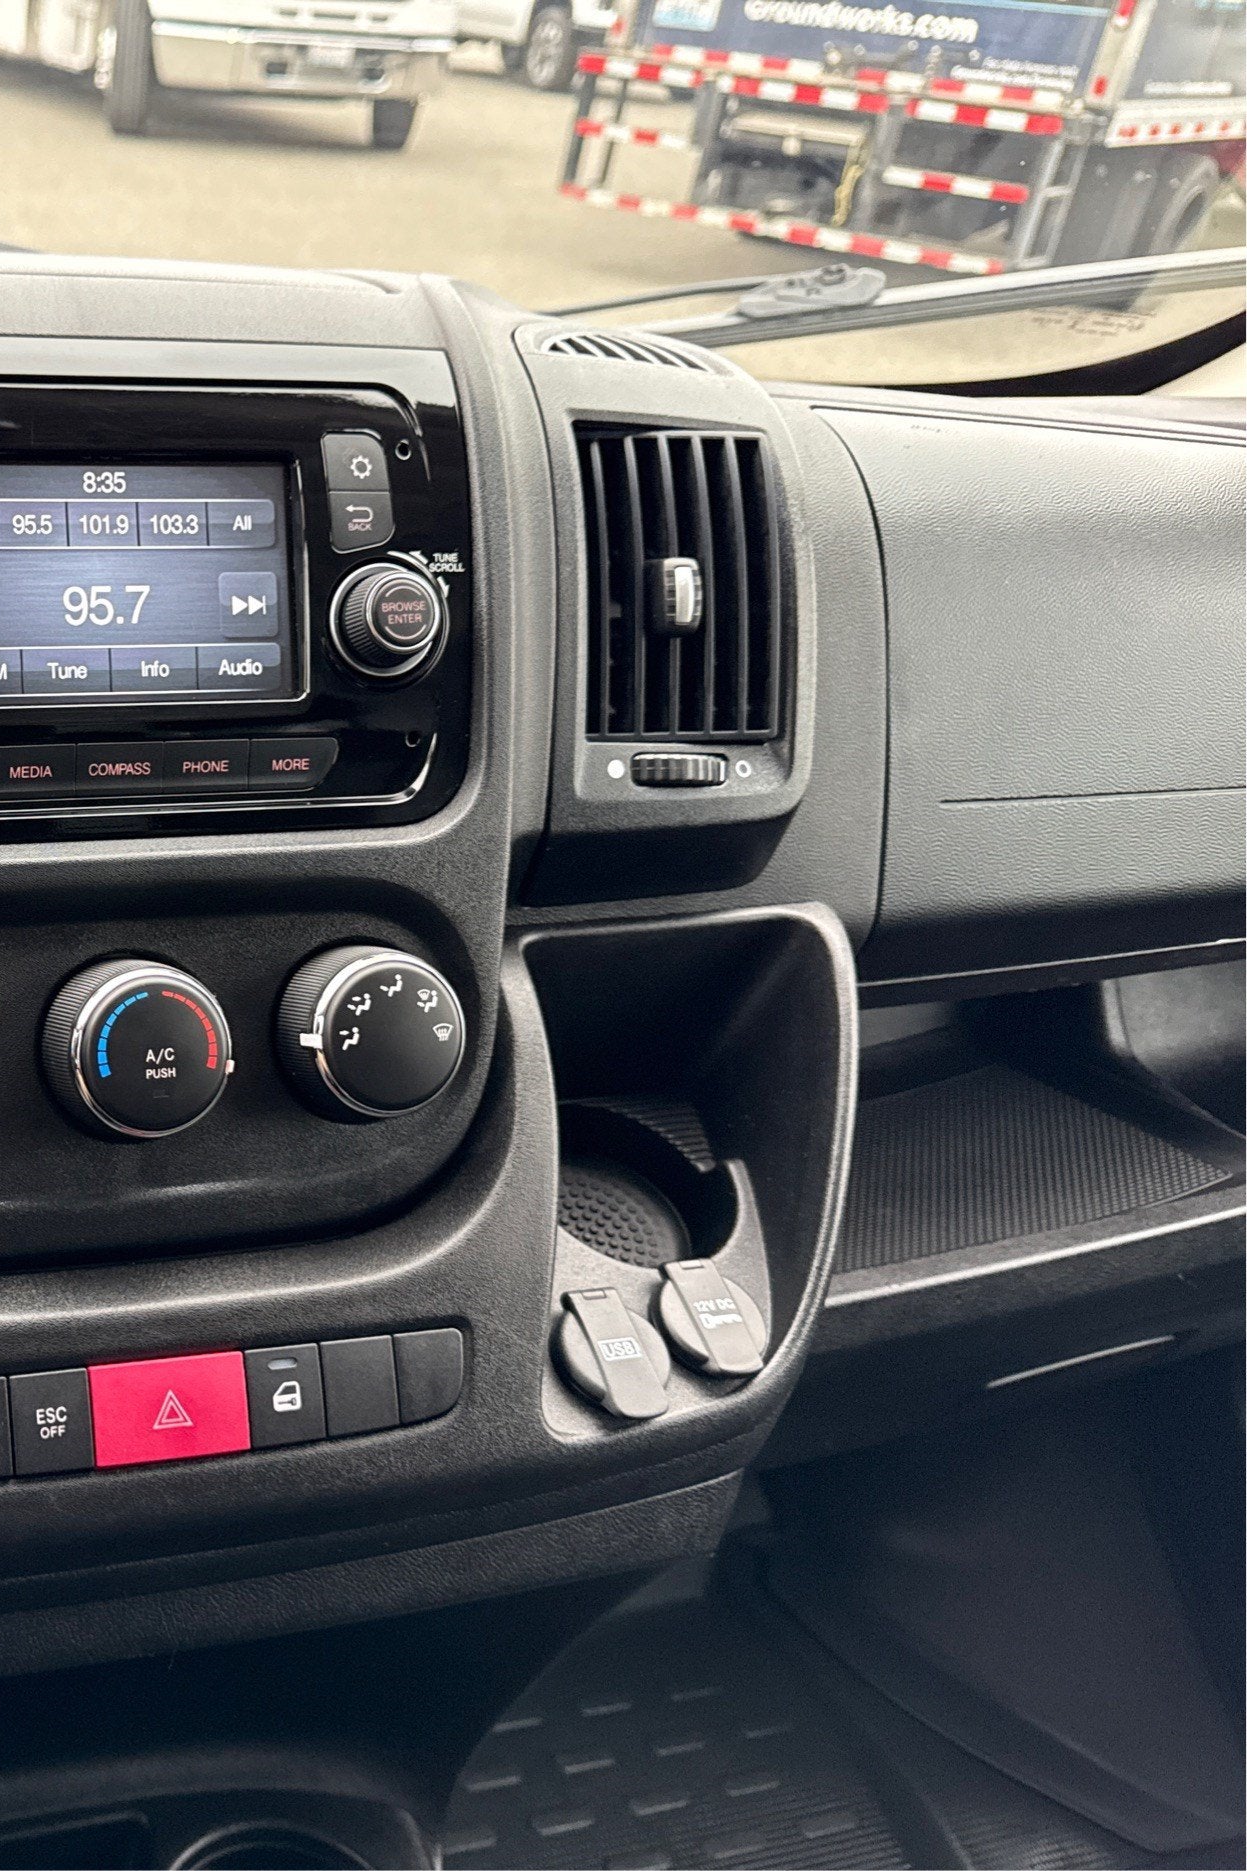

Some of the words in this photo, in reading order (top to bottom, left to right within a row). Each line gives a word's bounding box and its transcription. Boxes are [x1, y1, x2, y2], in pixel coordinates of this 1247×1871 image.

[82, 471, 127, 494] 8:35
[12, 514, 53, 535] 95.5
[78, 514, 130, 535] 101.9
[149, 514, 199, 535] 103.3
[232, 515, 252, 531] All
[348, 523, 372, 532] BACK
[432, 552, 459, 562] TUNE
[428, 562, 466, 573] SCROLL
[62, 585, 151, 627] 95.7
[381, 601, 427, 613] BROWSE
[387, 613, 423, 625] ENTER
[47, 661, 88, 680] Tune
[140, 660, 171, 678] Info
[218, 658, 263, 676] Audio
[88, 762, 151, 777] COMPASS
[182, 760, 230, 773] PHONE
[271, 758, 310, 771] MORE
[9, 766, 52, 779] MEDIA
[145, 1047, 176, 1065] A/C
[145, 1067, 177, 1080] PUSH
[694, 1300, 715, 1312] 12V
[718, 1298, 736, 1310] DC
[604, 1340, 637, 1356] USB
[36, 1406, 67, 1425] ESC
[40, 1424, 66, 1439] OFF
